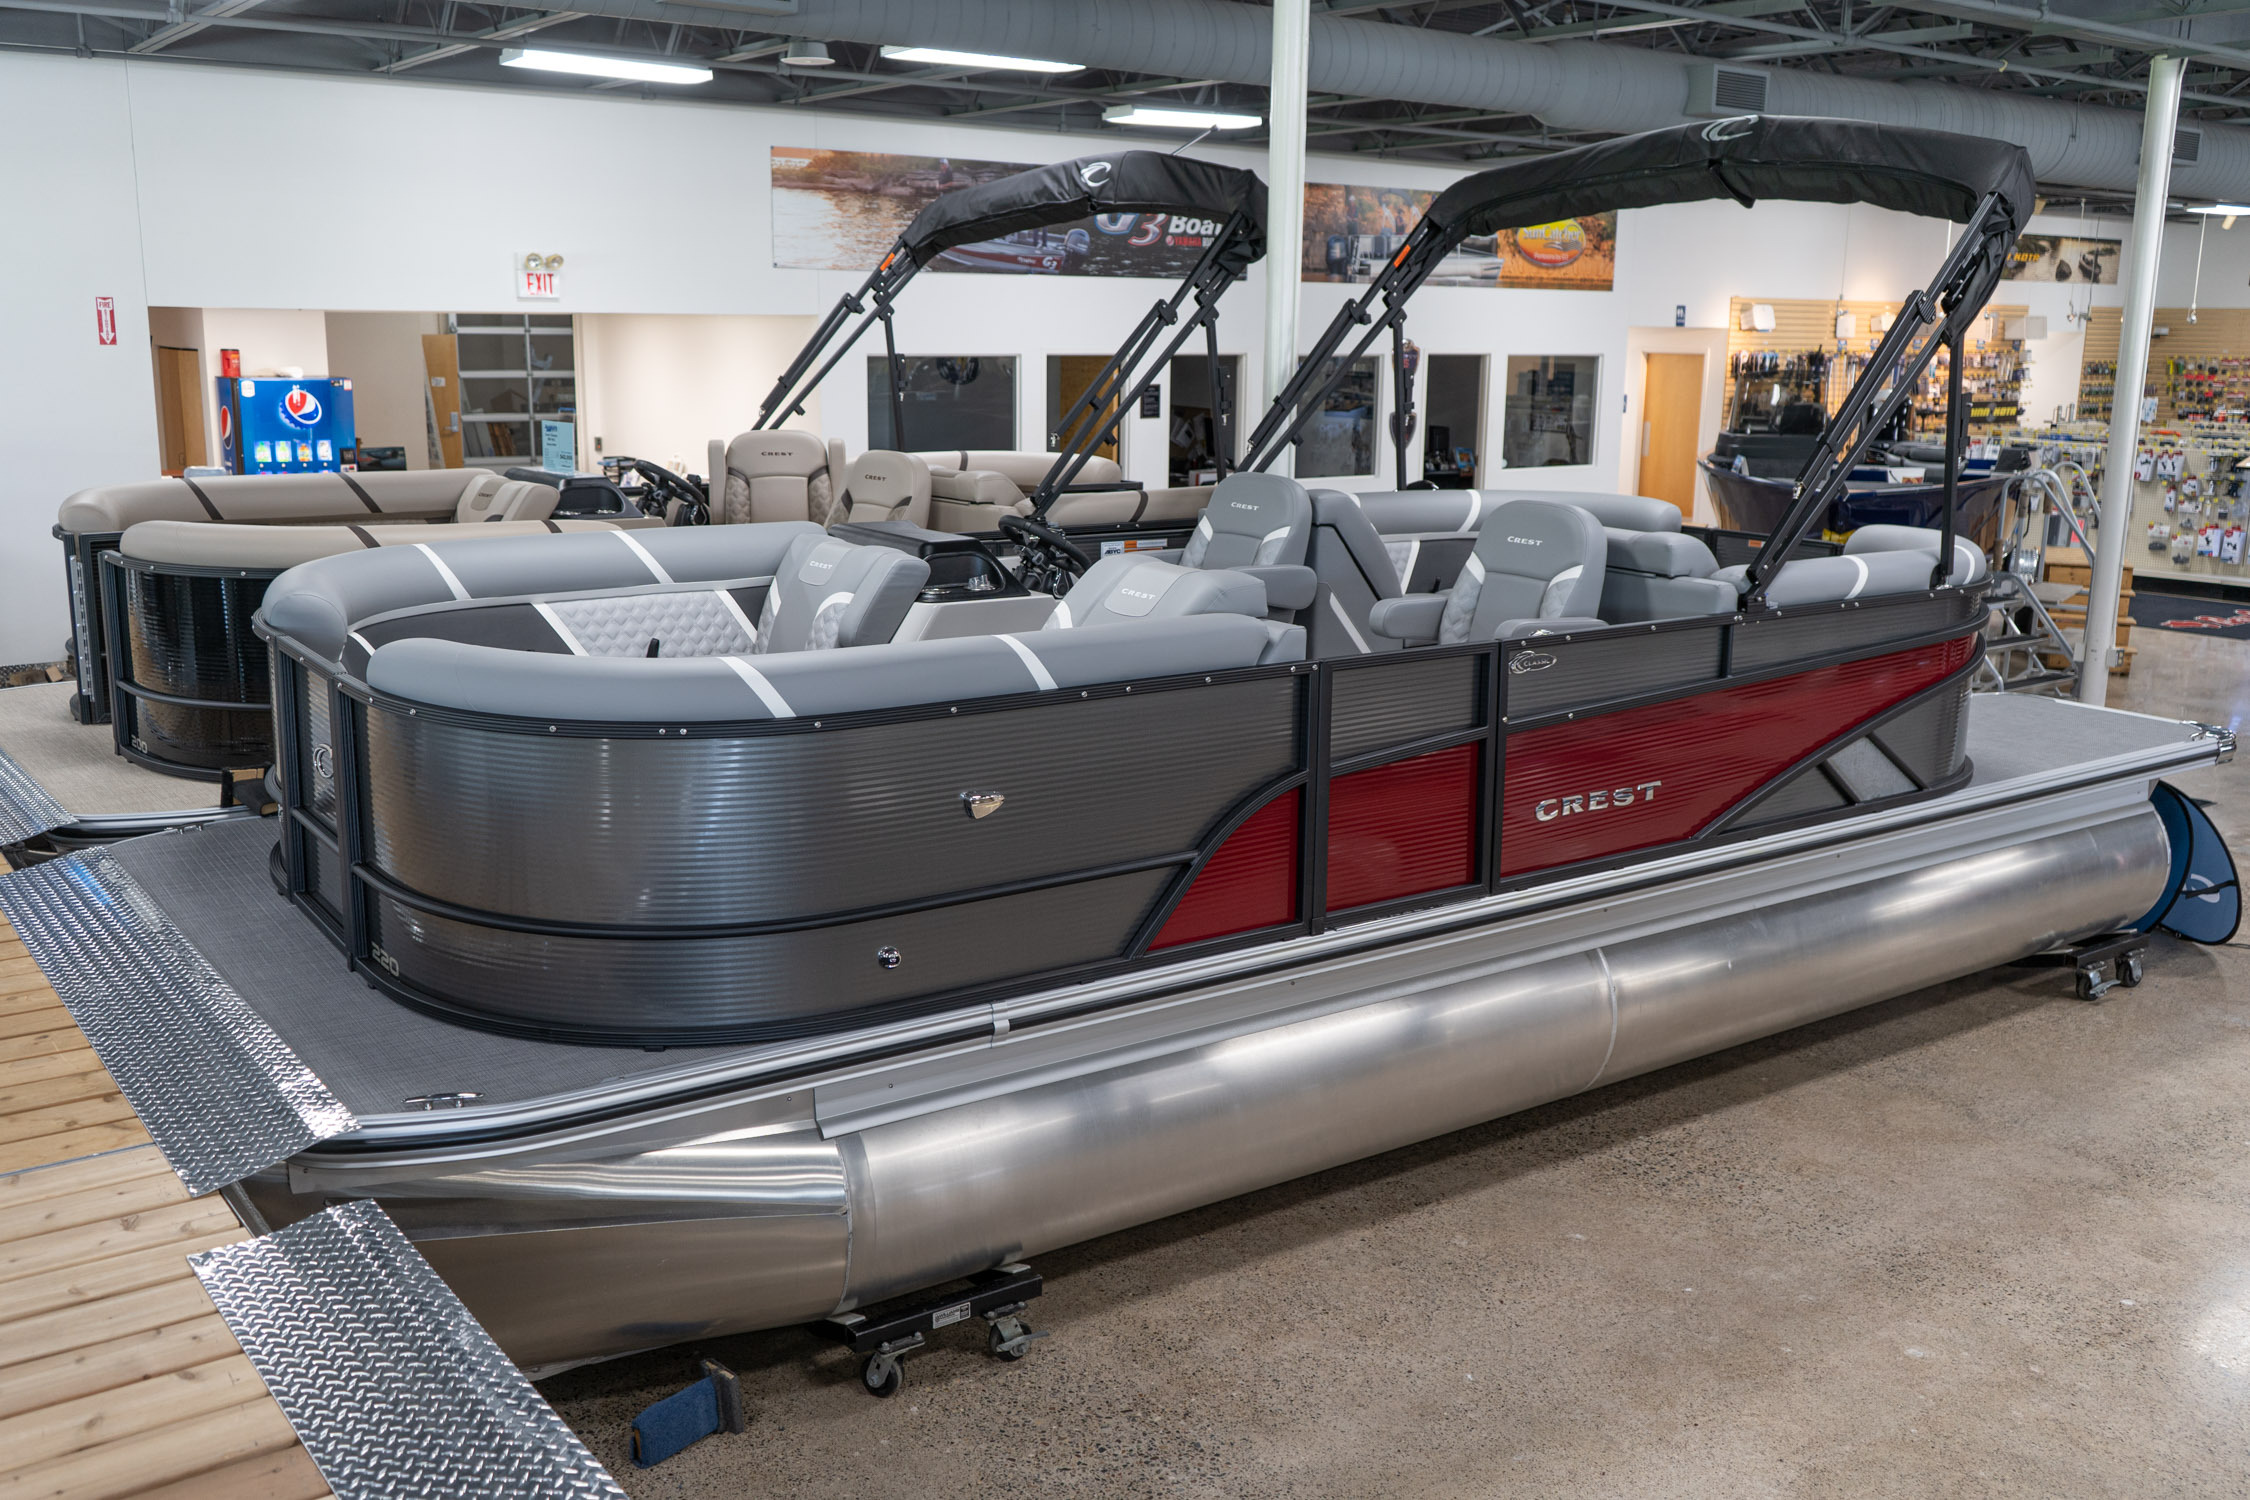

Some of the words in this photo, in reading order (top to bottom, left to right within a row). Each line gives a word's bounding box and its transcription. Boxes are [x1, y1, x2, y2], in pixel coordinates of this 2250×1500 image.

[527, 272, 554, 295] EXIT
[1993, 406, 2017, 416] KOTA
[1231, 501, 1260, 511] CREST
[1507, 535, 1543, 546] CREST
[810, 560, 832, 570] CREST
[1121, 588, 1156, 600] CREST
[131, 734, 148, 754] 200
[1535, 780, 1662, 822] CREST
[371, 940, 399, 977] 220
